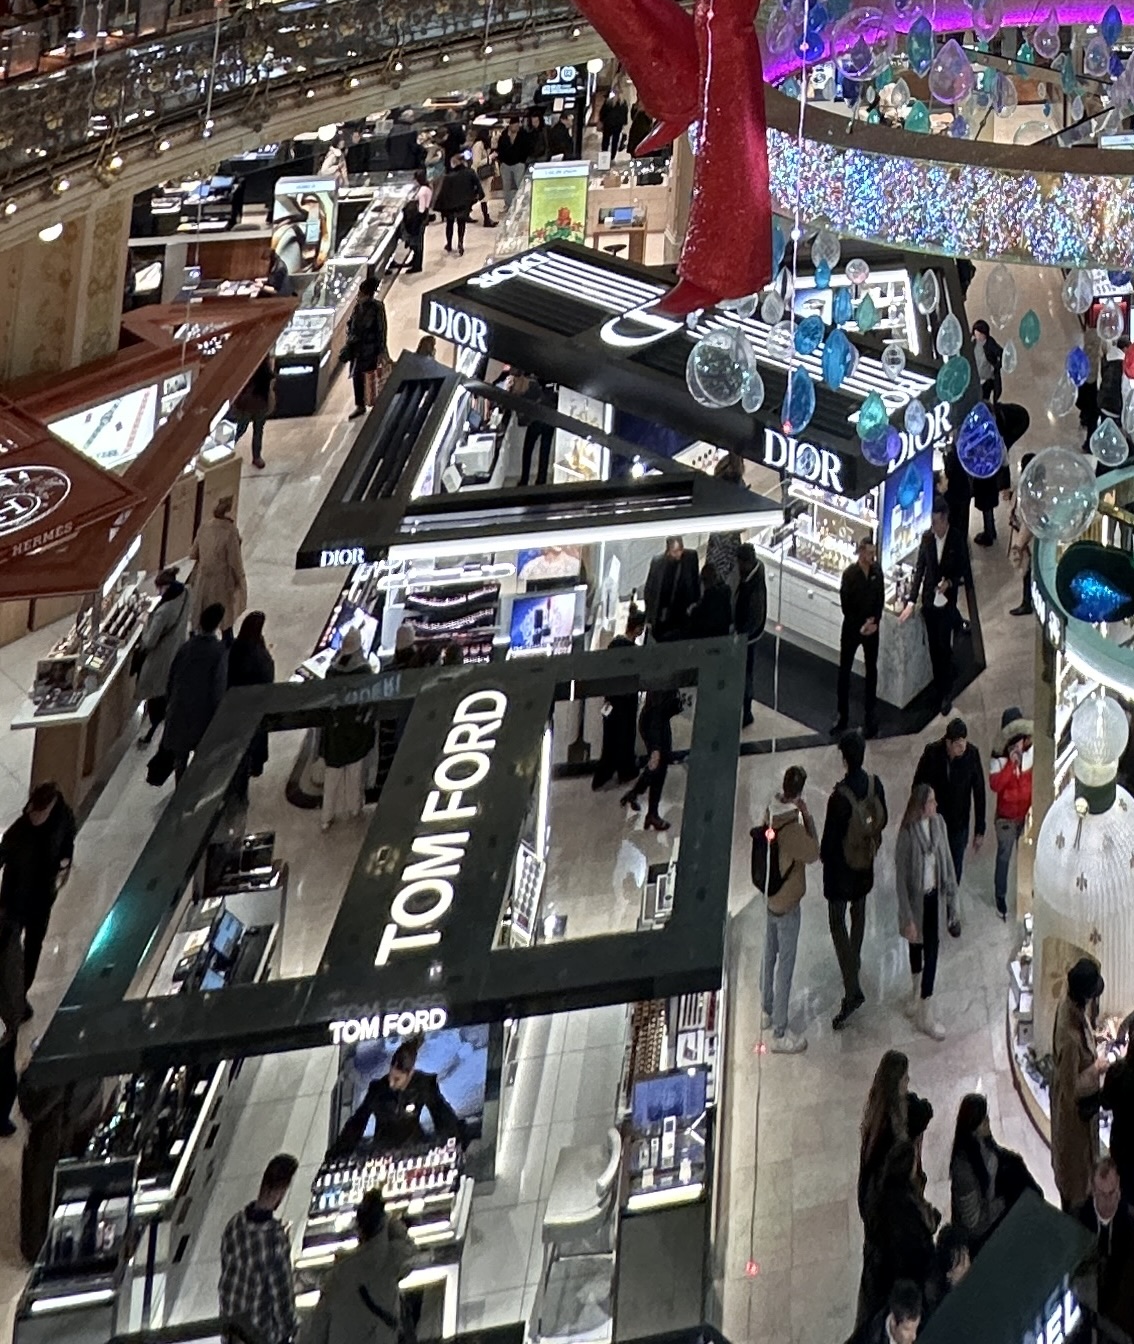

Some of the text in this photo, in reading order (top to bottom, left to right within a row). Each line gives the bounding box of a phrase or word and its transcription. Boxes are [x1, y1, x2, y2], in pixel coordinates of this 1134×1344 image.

[428, 300, 489, 353] DIOR
[763, 428, 844, 493] DIOR
[320, 547, 366, 567] DIOR
[374, 689, 508, 967] TOM FORD
[328, 1007, 447, 1045] TOM FORD
